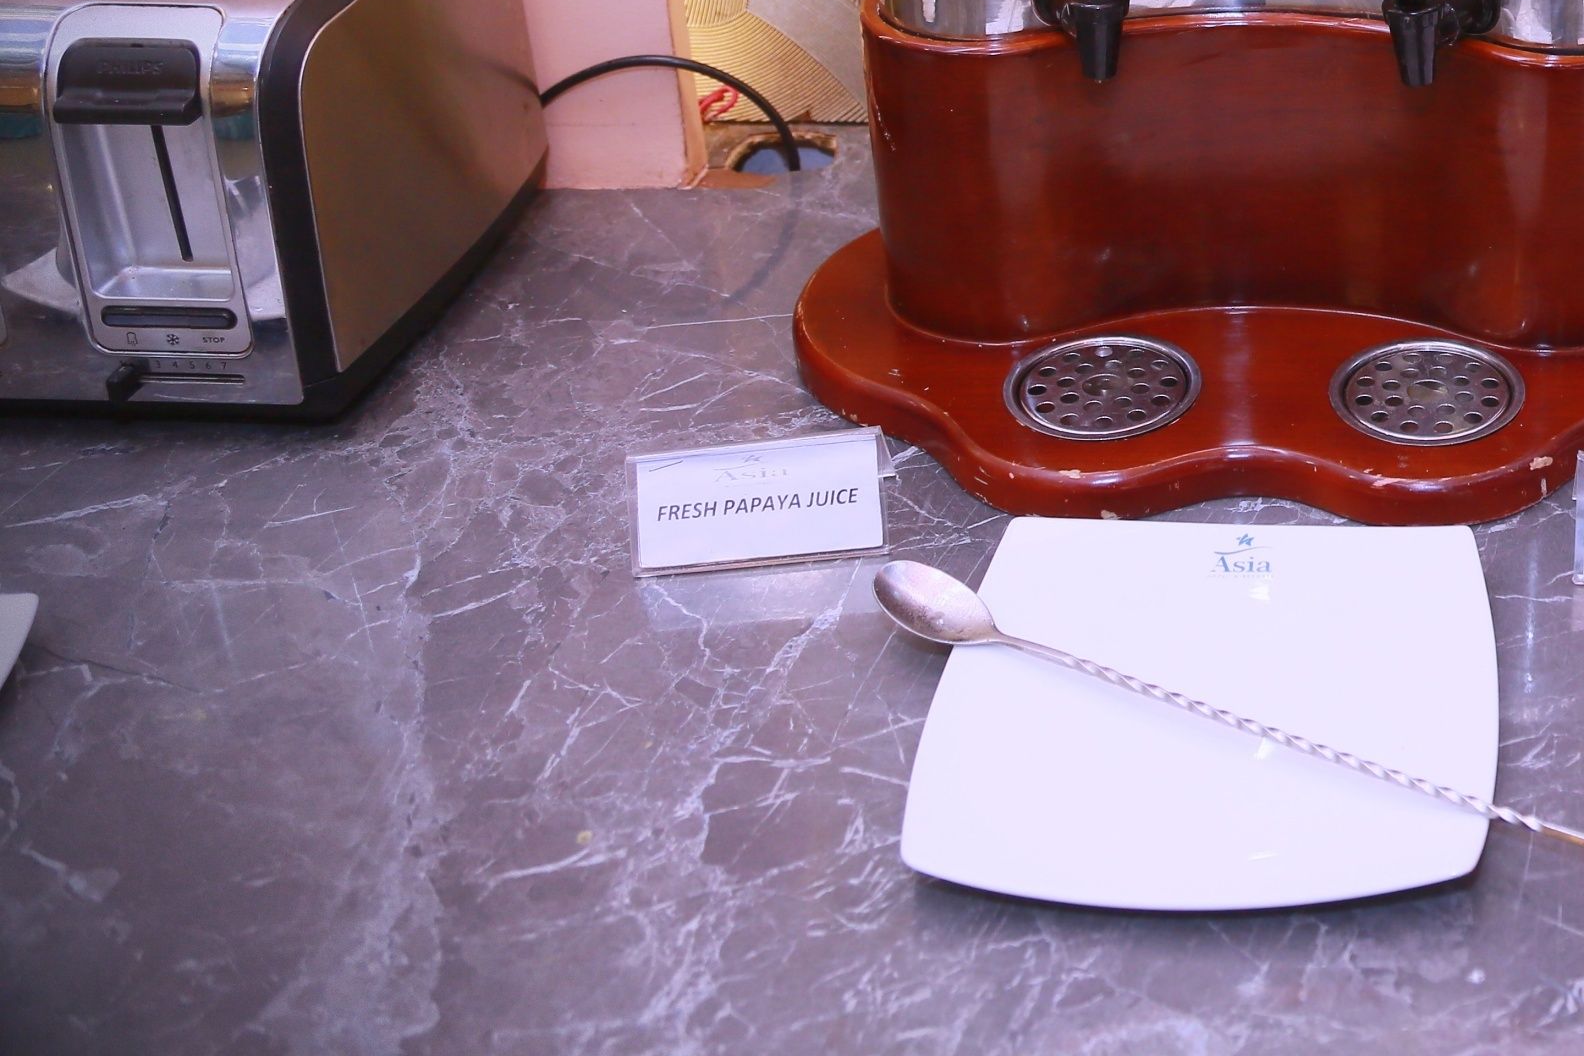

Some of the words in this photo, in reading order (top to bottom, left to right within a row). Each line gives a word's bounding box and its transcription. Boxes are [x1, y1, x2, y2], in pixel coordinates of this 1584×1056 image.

[96, 59, 166, 75] PHILIPS
[202, 336, 225, 344] STOP
[657, 501, 717, 521] FRESH
[724, 493, 801, 515] PAPAYA
[807, 487, 859, 508] JUICE
[1210, 555, 1272, 573] Asia
